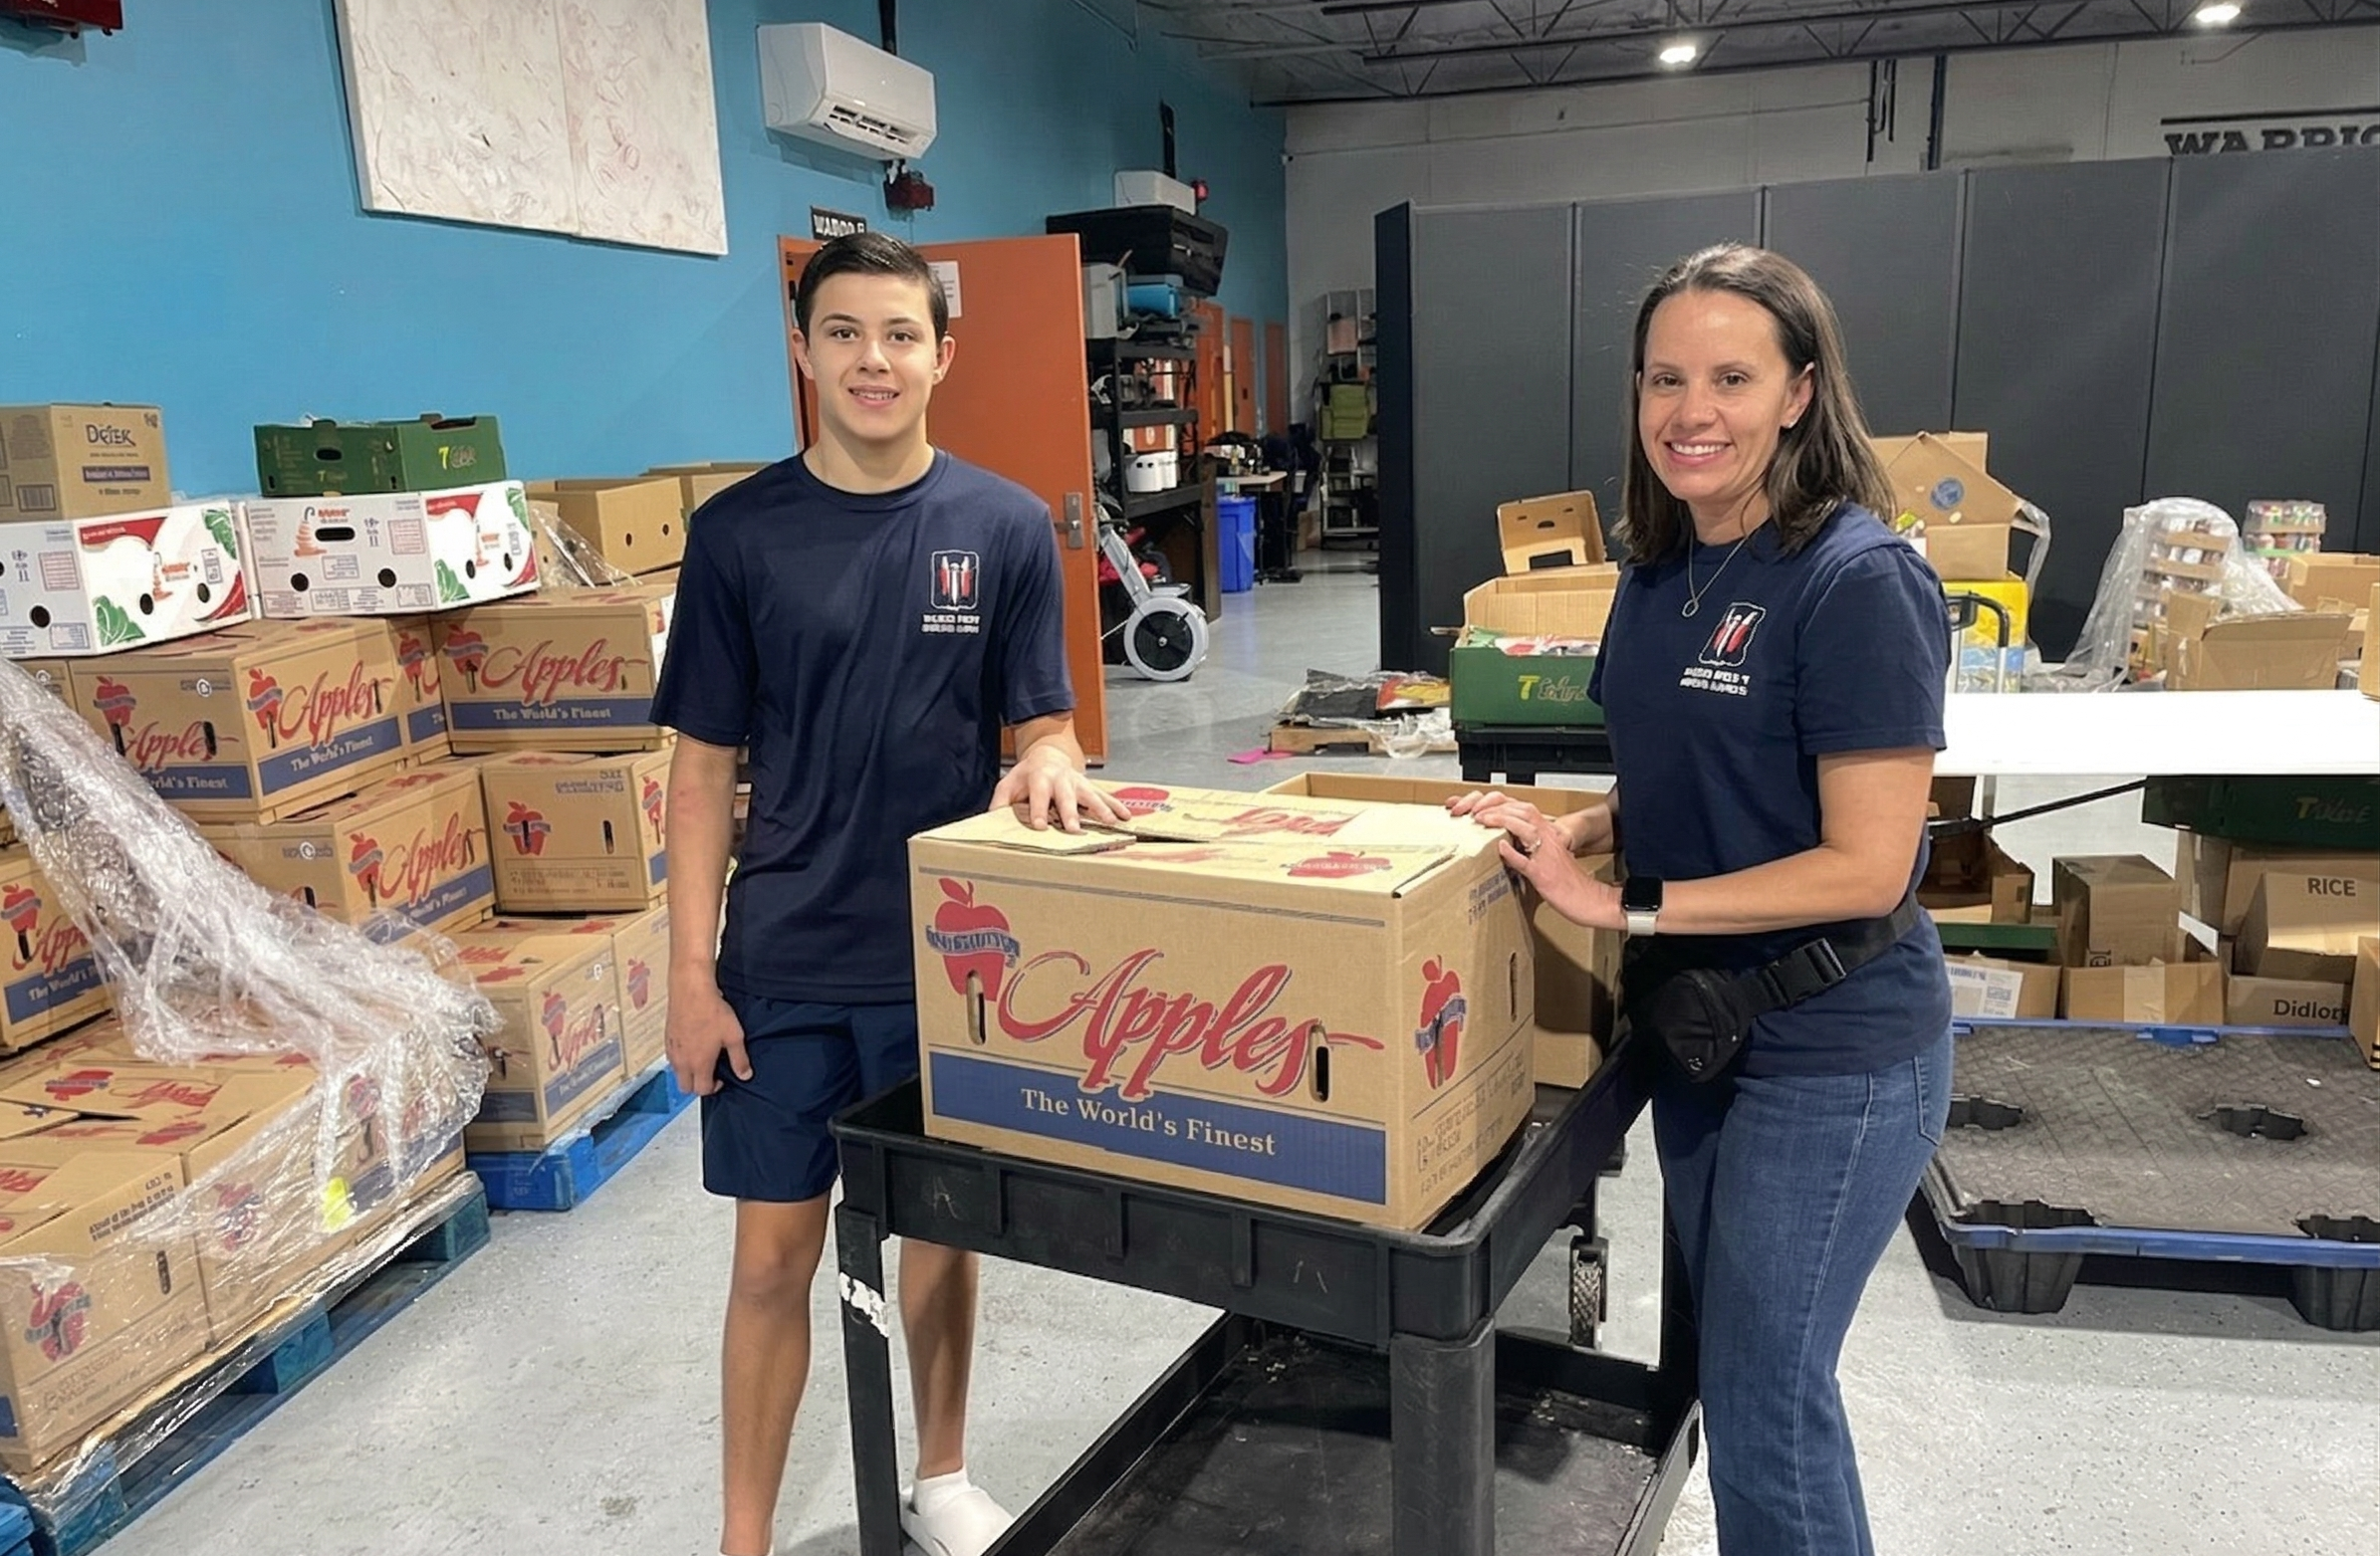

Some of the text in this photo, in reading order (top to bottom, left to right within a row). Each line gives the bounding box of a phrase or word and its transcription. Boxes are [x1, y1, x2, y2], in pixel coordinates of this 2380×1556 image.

[278, 660, 394, 748] Apples
[481, 639, 649, 706] Apples
[124, 721, 239, 771] Apple
[493, 708, 519, 720] The
[150, 775, 185, 789] rld's
[378, 811, 486, 906] Apples
[2306, 876, 2357, 897] RICE
[997, 947, 1385, 1099] Apples
[1021, 1087, 1277, 1156] The World's Finest
